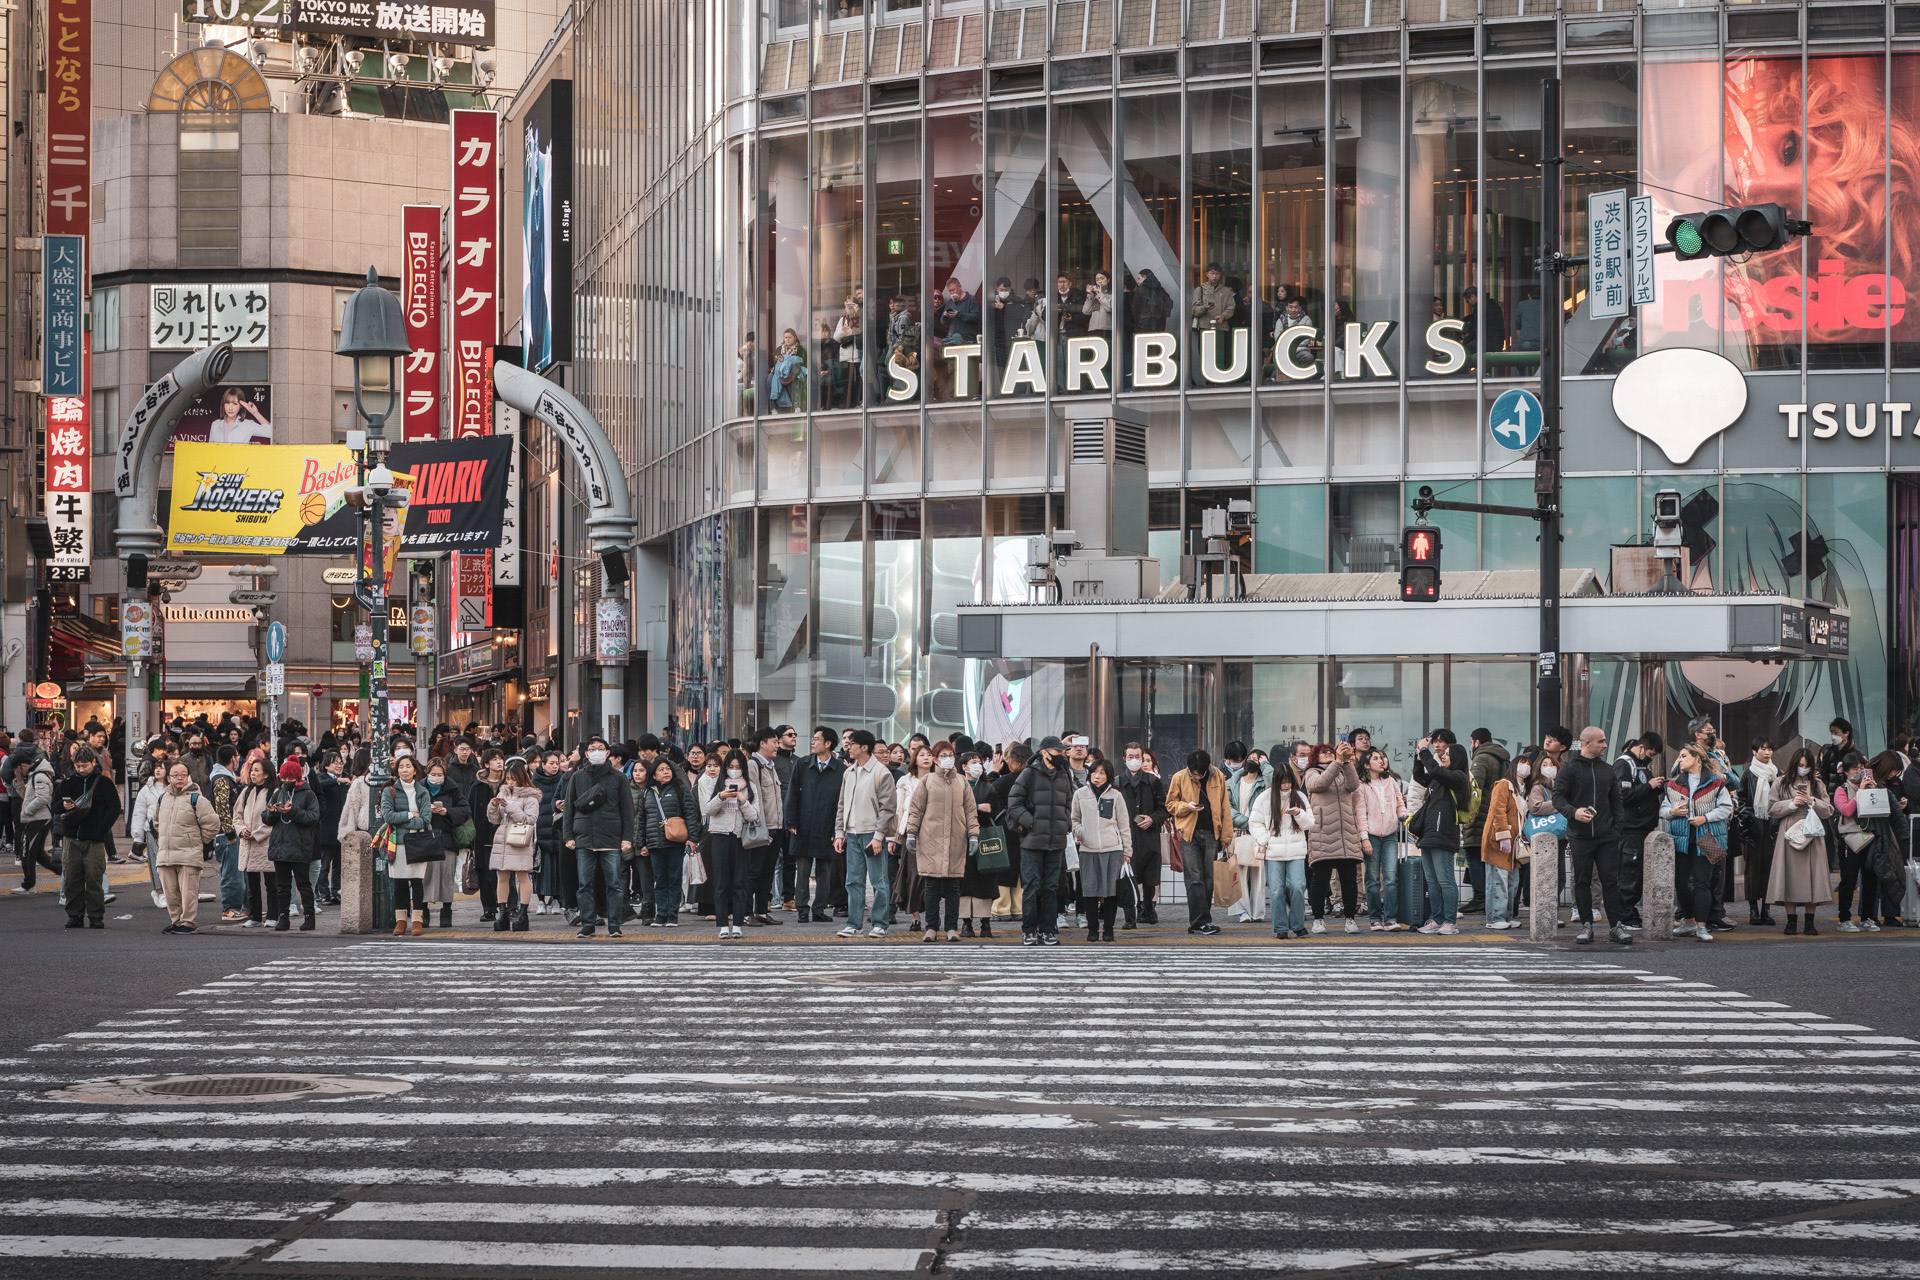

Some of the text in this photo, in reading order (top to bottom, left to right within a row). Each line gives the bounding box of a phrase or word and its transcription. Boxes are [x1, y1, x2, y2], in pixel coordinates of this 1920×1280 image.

[282, 0, 292, 25] ED
[375, 2, 486, 37] 放送開始
[456, 136, 493, 317] カラオケ
[561, 200, 571, 242] 1st Single
[1593, 219, 1604, 297] Shibuya Sta.
[1605, 201, 1623, 307] 渋谷駅前
[1634, 200, 1651, 301] スクランブル式
[409, 232, 428, 328] BIG ECHO
[1663, 258, 1907, 333] rosie
[51, 244, 76, 388] 大盛堂商事ビル
[183, 290, 267, 314] れいわ
[154, 321, 267, 345] クリニック
[460, 340, 482, 384] BIG
[887, 318, 1467, 401] STARBUCKS
[253, 392, 266, 402] 4F
[51, 397, 85, 489] 輪焼肉
[117, 380, 171, 493] 渋谷センター街
[180, 433, 207, 442] VINCI
[543, 399, 603, 502] 渋谷センター街
[180, 471, 284, 514] ROCKERS
[218, 472, 245, 487] SUN
[408, 459, 488, 506] ALVARK
[53, 494, 84, 555] 牛繁
[235, 514, 268, 524] SHIBUYA
[427, 508, 451, 524] TOKYO
[326, 571, 357, 579] 渋谷セン
[460, 614, 471, 622] 入口
[1531, 813, 1557, 830] Lee
